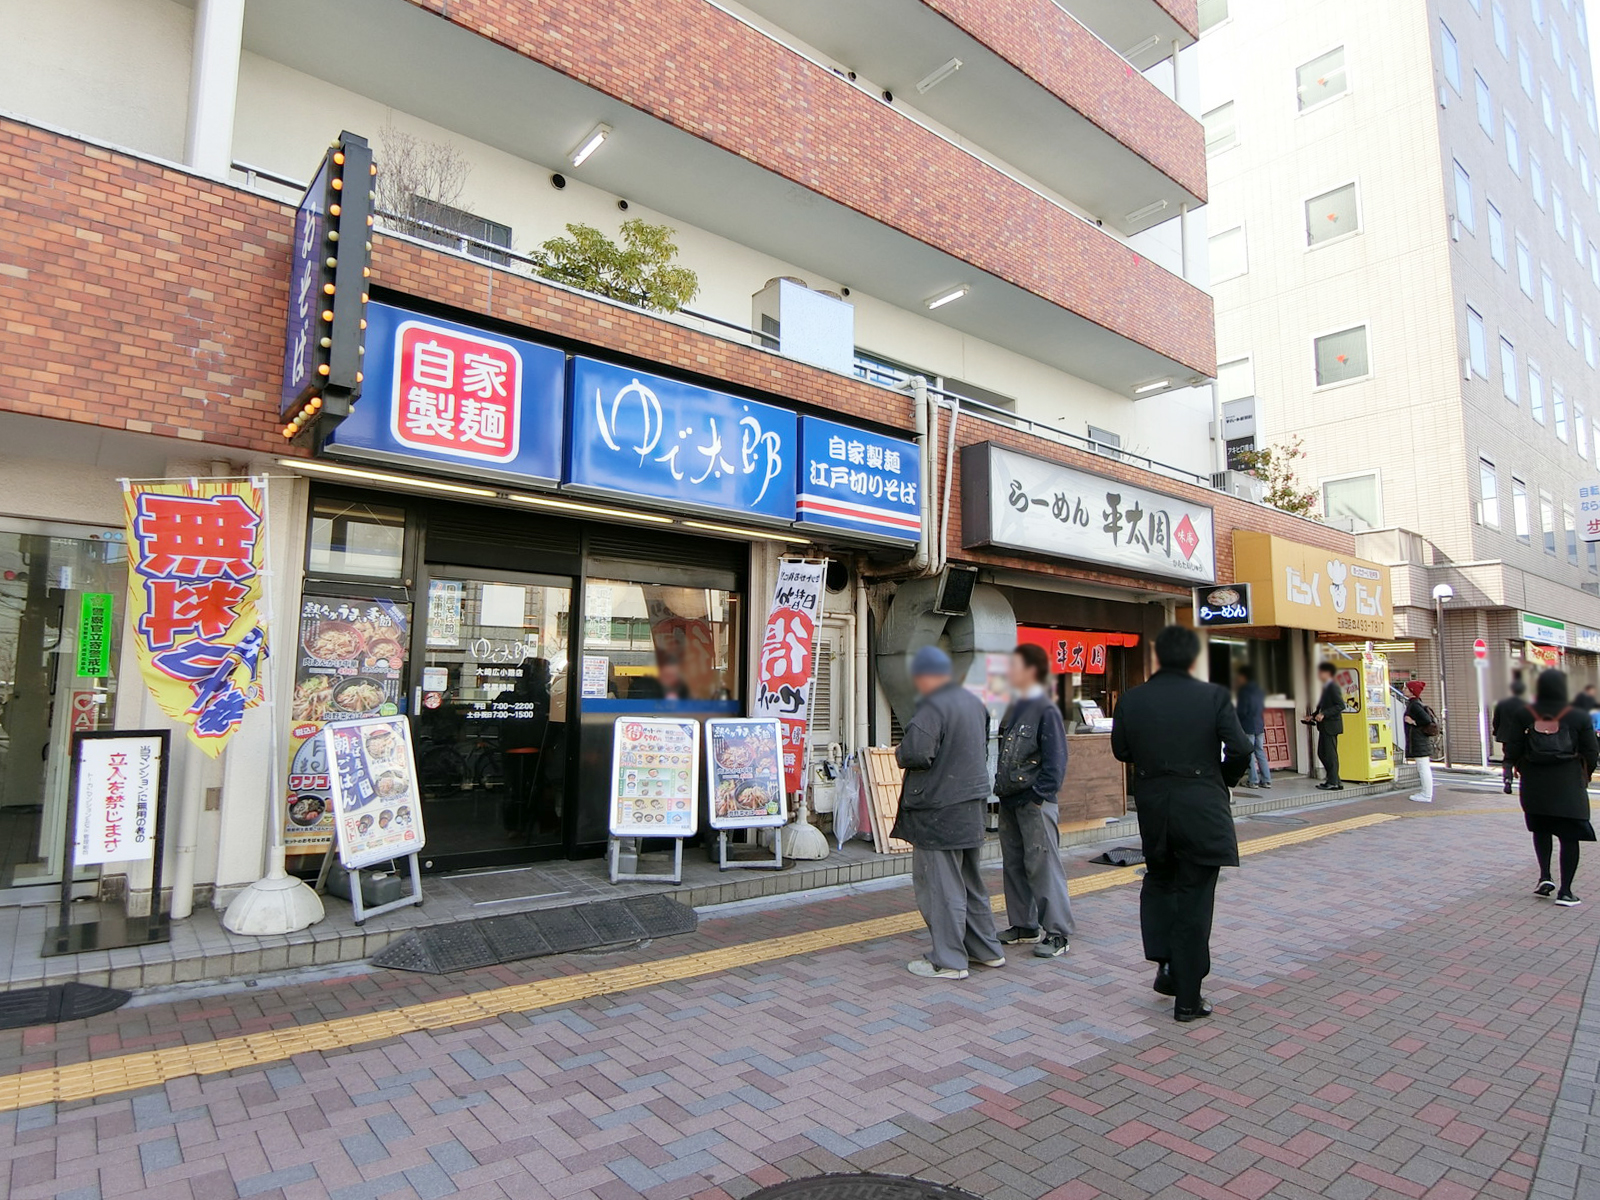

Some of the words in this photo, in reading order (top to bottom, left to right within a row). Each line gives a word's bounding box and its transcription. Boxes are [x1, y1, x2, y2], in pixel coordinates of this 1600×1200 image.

[291, 200, 317, 388] おそば
[413, 340, 508, 399] 自家
[405, 385, 506, 449] 製麺
[595, 378, 783, 508] ゆで太郎
[809, 459, 917, 506] 江戸切りそば
[828, 435, 902, 475] 自家製麺
[1008, 479, 1090, 528] らーめん
[1102, 492, 1172, 559] 平太周
[87, 607, 105, 676] 警察官立寄警戒中
[302, 601, 393, 627] 熱々がうまい季節
[1200, 604, 1247, 620] らーめん
[470, 637, 530, 668] ゆで太郎
[475, 667, 524, 678] 大崎広小路店
[1056, 640, 1106, 671] 平太周
[333, 733, 358, 810] 朝ごはん
[103, 752, 128, 853] 立入を禁じます
